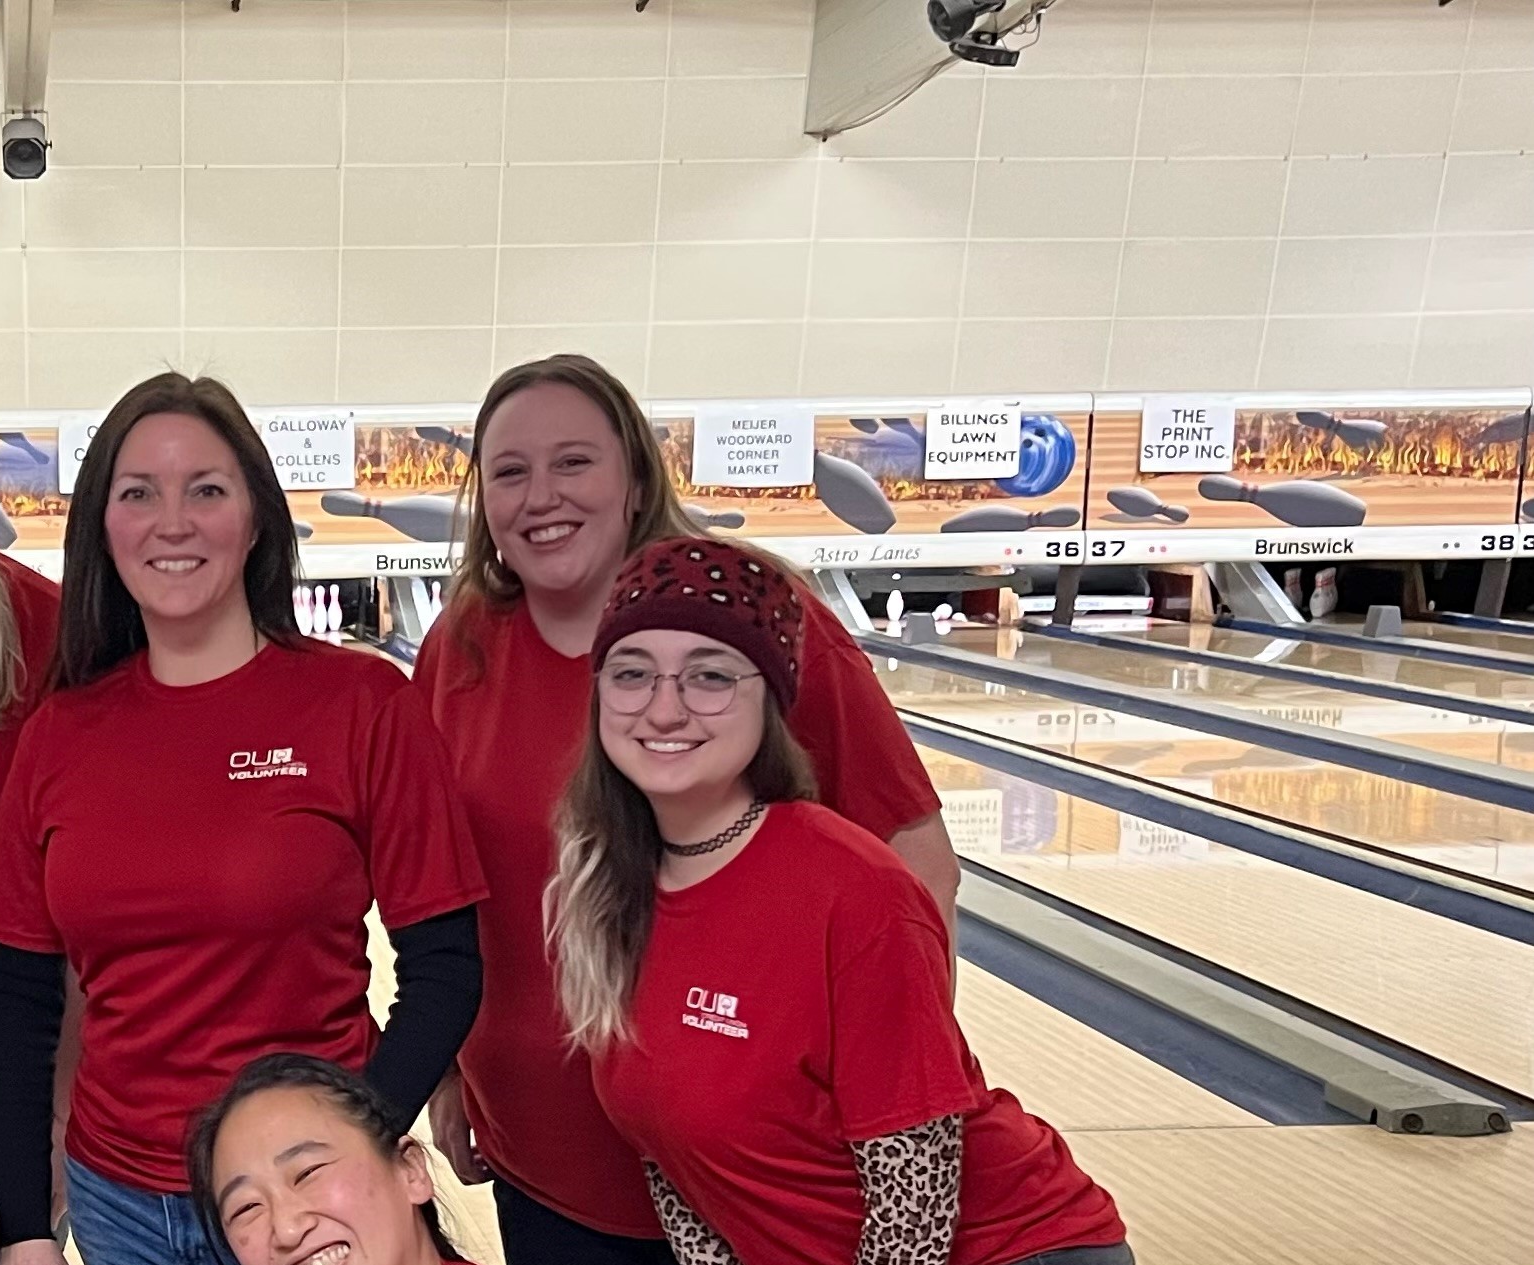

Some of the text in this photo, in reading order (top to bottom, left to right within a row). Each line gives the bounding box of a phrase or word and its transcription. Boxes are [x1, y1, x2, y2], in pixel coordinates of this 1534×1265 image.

[940, 414, 1008, 426] BILLINGS
[1172, 409, 1206, 424] THE
[268, 420, 346, 432] GALLOWAY
[732, 420, 777, 430] MEIJER
[716, 434, 792, 446] WOODWARD
[952, 432, 996, 444] LAWN
[1162, 427, 1214, 441] PRINT
[304, 438, 312, 448] &
[728, 450, 779, 460] CORNER
[928, 451, 1017, 464] EQUIPMENT
[1144, 444, 1230, 459] STOP INC.
[276, 454, 341, 466] COLLENS
[728, 464, 779, 475] MARKET
[290, 472, 326, 483] PLLC
[1092, 540, 1126, 557] 37
[1254, 537, 1354, 556] Brunswick
[1481, 535, 1514, 550] 38
[810, 546, 920, 563] Astro Lanes
[1046, 541, 1079, 558] 36
[228, 767, 308, 780] VOLUNTEER
[682, 1014, 749, 1040] VOLUNTEER
